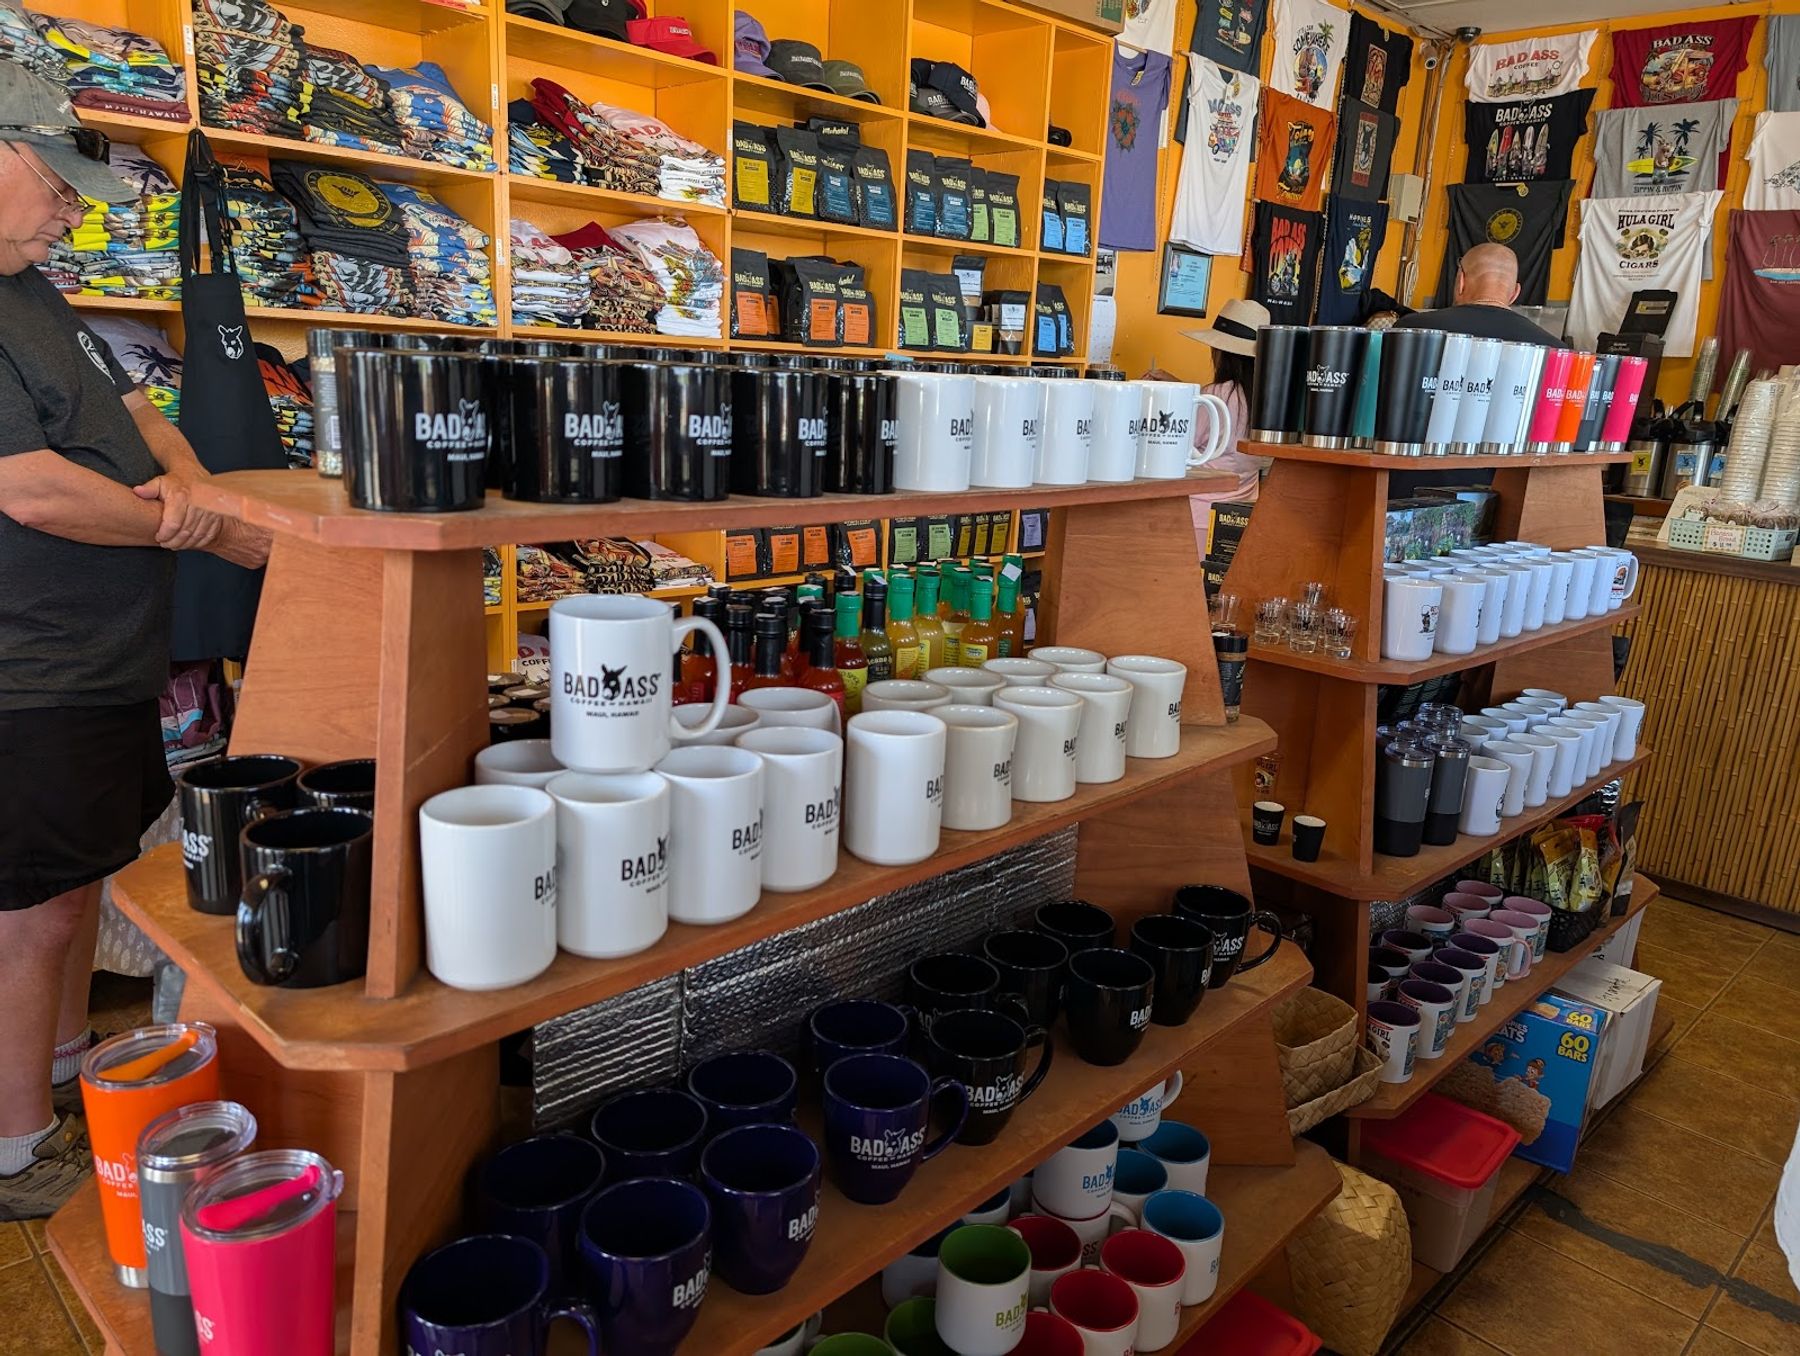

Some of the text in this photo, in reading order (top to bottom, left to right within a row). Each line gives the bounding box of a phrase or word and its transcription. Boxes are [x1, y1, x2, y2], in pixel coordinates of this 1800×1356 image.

[1653, 35, 1712, 49] BAD ASS
[1496, 49, 1559, 70] BAD ASS
[1513, 62, 1539, 70] COFFEE
[928, 95, 943, 105] BAD
[1495, 103, 1553, 123] BAD ASS
[628, 124, 662, 136] AD
[1617, 214, 1675, 230] HULA GIRL
[1619, 260, 1659, 269] CIGARS
[735, 273, 764, 286] BAD ASS
[809, 281, 836, 292] BAD ASS
[1326, 372, 1347, 384] ASS
[1442, 380, 1460, 391] BAD
[1467, 382, 1486, 393] BAD
[1546, 388, 1562, 399] BAD
[1566, 390, 1582, 400] BAD
[415, 412, 460, 440] BAD
[564, 413, 601, 438] BAD
[688, 414, 721, 438] BAD
[798, 418, 823, 439] BAD
[950, 419, 970, 436] BAD
[1140, 419, 1189, 434] AD ASS
[426, 441, 466, 449] COFFEE
[573, 438, 608, 446] COFFEE
[1219, 514, 1233, 524] BAD
[1236, 516, 1249, 526] ASS
[1208, 573, 1220, 584] BAD
[522, 658, 550, 667] COFF
[564, 671, 660, 699] BAD ASS
[570, 697, 606, 707] COFFEE
[805, 799, 833, 824] BAD
[732, 821, 759, 850] BAD
[621, 852, 656, 881] BAD
[1222, 936, 1243, 952] ASS
[1130, 1006, 1152, 1026] BAD
[1566, 1017, 1591, 1030] BARS
[1568, 1011, 1593, 1024] 60
[1371, 1025, 1391, 1042] GIRL
[1560, 1031, 1590, 1054] 60
[1558, 1046, 1588, 1063] BARS
[965, 1085, 995, 1102] BAD
[850, 1127, 926, 1157] BAD ASS
[95, 1155, 125, 1183] BAD
[1082, 1173, 1104, 1189] BAD
[788, 1211, 816, 1240] BAD
[1082, 1240, 1098, 1257] SS
[673, 1270, 707, 1307] BAD
[996, 1304, 1020, 1327] BAD
